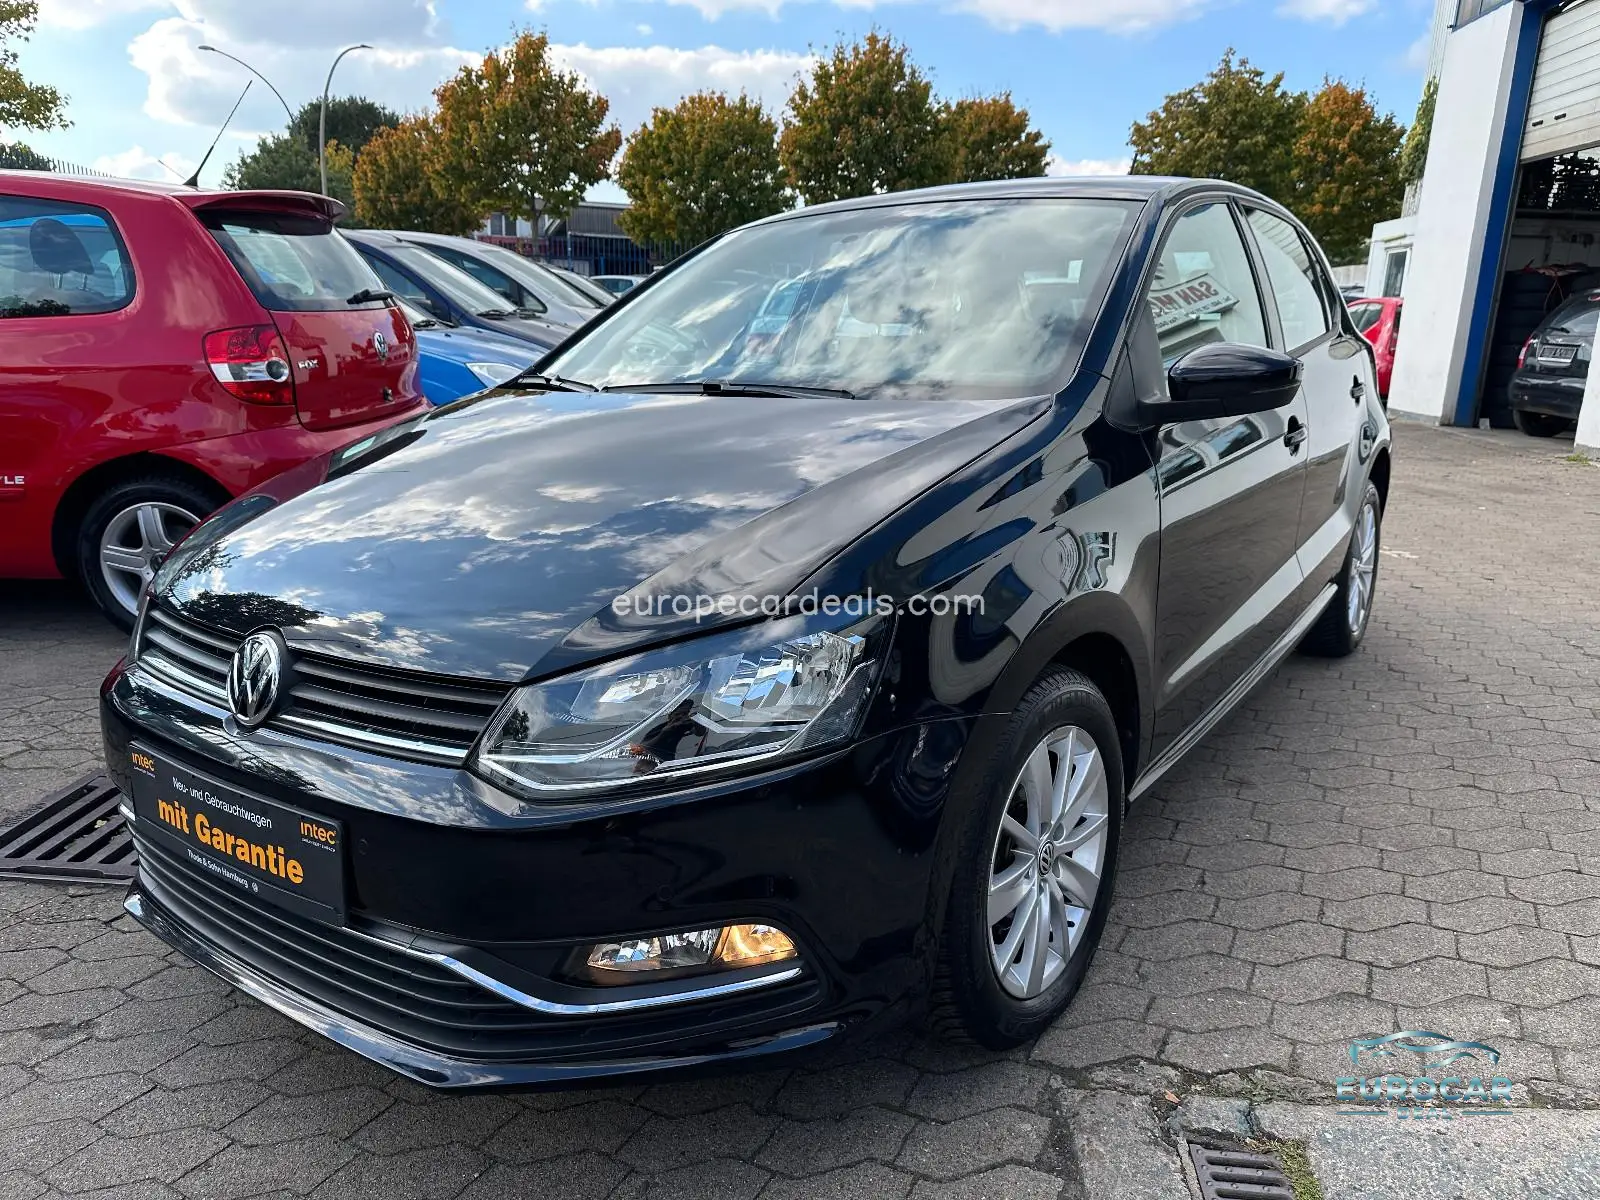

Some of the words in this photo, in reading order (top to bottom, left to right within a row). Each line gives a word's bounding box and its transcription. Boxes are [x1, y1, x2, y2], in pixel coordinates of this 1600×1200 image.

[297, 359, 319, 370] FOX
[0, 475, 25, 485] LE
[131, 752, 155, 772] intec
[172, 776, 189, 793] Neu-
[190, 787, 204, 801] und
[204, 791, 273, 829] Gebrauchtwagen
[158, 798, 190, 835] mit
[194, 813, 304, 884] Garantie
[300, 821, 337, 845] intec
[221, 867, 249, 889] Hamburg
